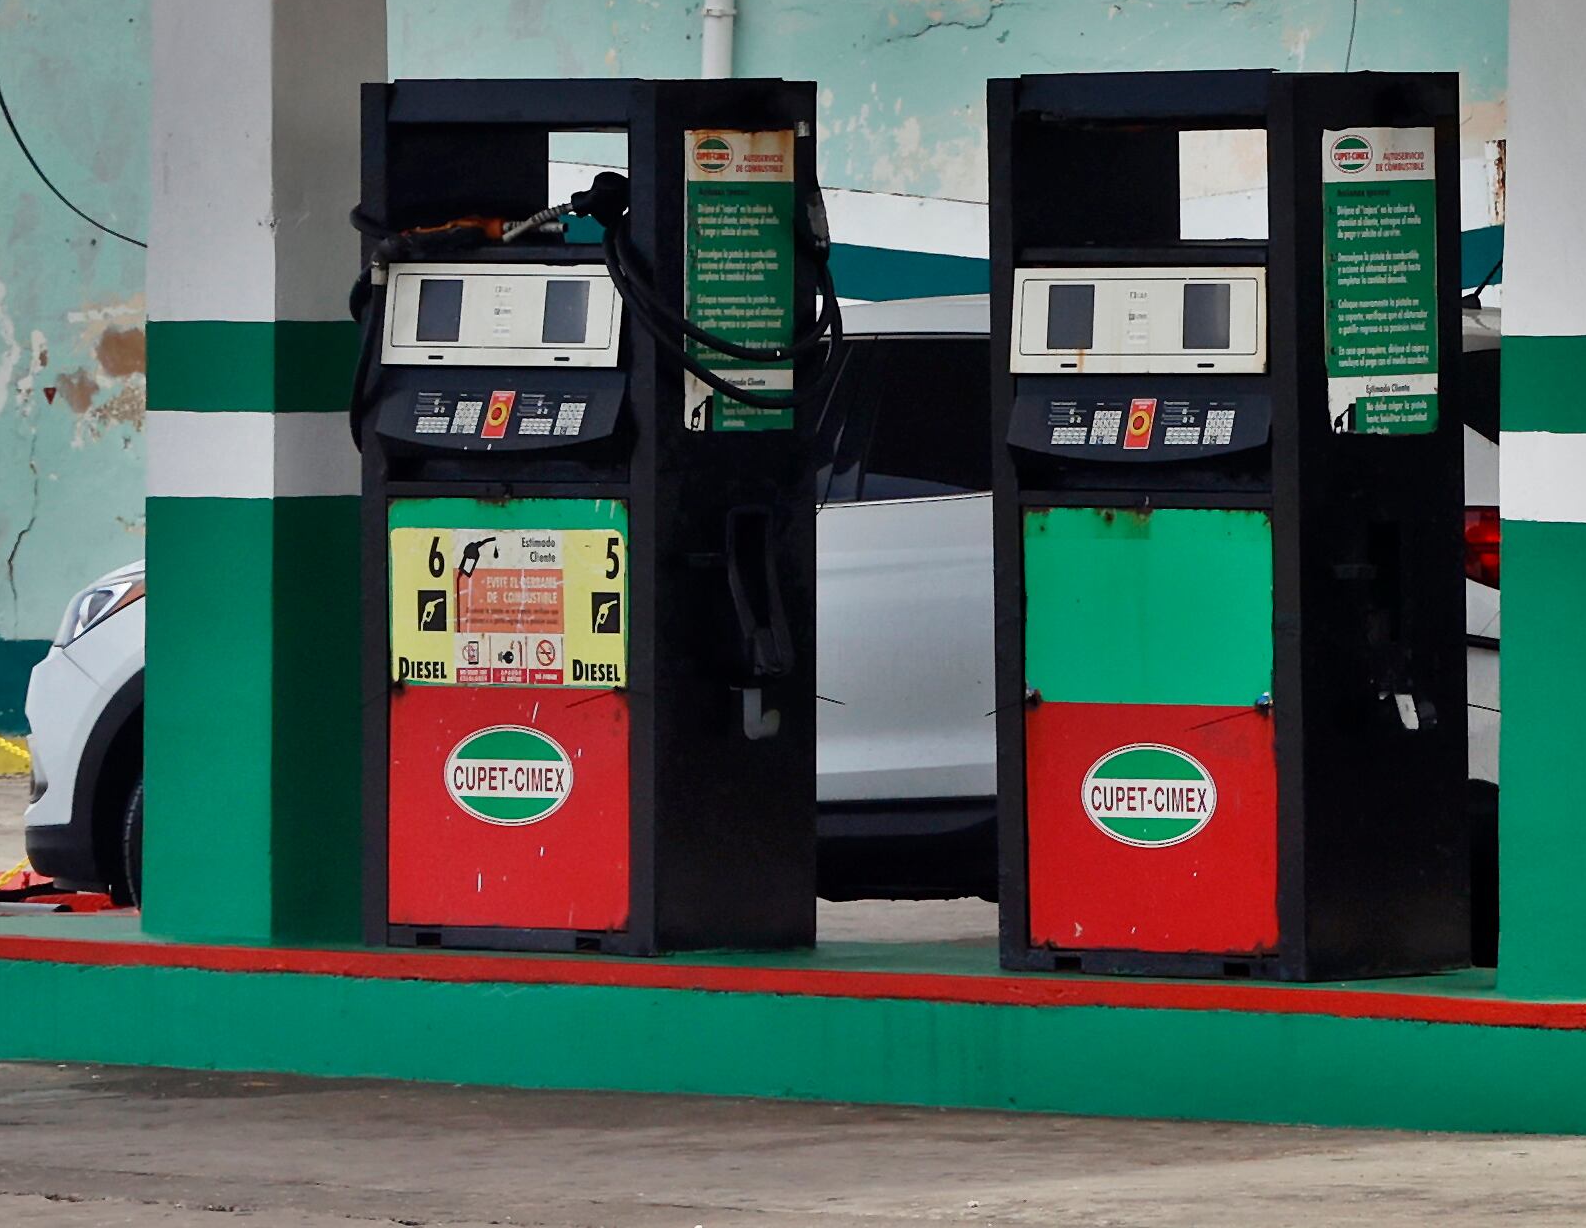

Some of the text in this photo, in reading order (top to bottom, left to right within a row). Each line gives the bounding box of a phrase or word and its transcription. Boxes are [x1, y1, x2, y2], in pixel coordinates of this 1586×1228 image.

[521, 537, 556, 548] Estimado
[428, 536, 445, 578] 6
[530, 551, 556, 563] Cliente
[606, 537, 620, 579] 5
[486, 576, 508, 589] EVITE
[510, 576, 519, 589] EL
[487, 592, 558, 604] DE COMBUSTIBLE
[398, 656, 447, 680] DIESEL
[572, 659, 621, 682] DIESEL
[453, 765, 566, 793] CUPET-CIMEX
[1091, 785, 1208, 814] CUPET-CIMEX
